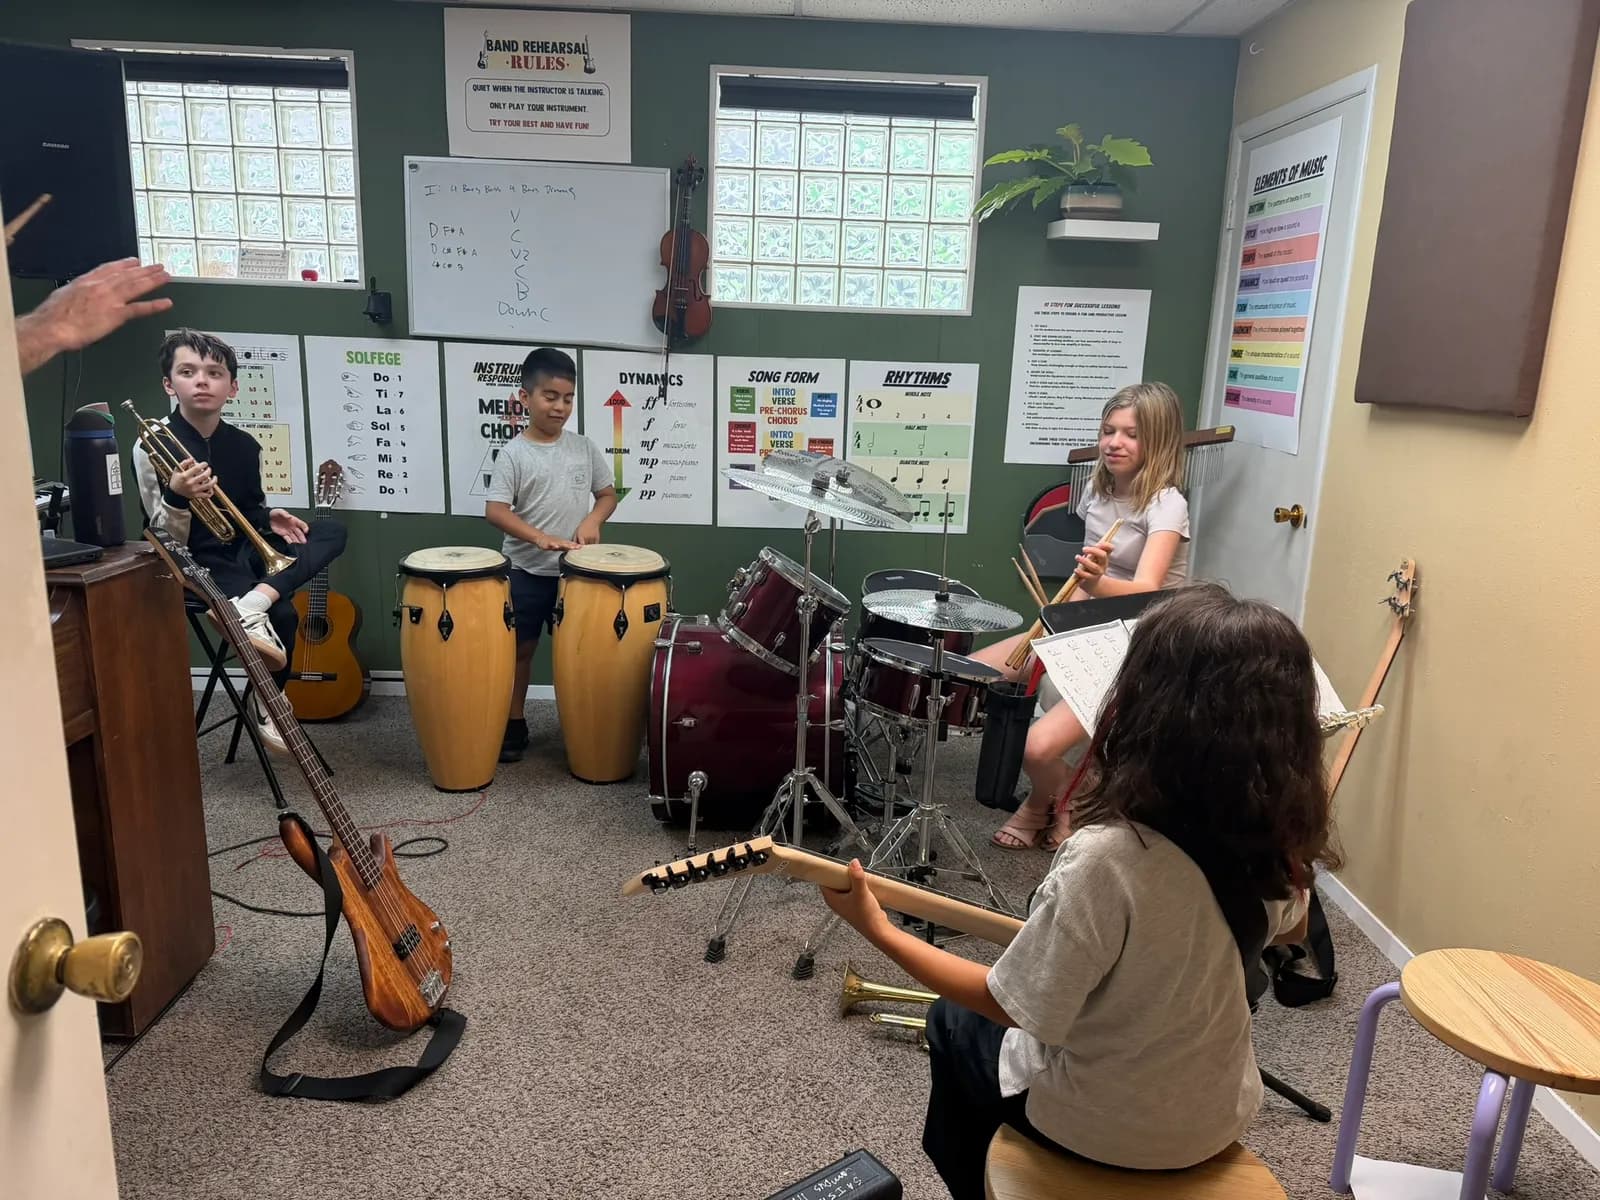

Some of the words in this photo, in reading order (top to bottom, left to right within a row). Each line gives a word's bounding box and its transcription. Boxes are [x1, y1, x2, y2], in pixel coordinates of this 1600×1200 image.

[487, 40, 518, 52] BAND
[523, 41, 588, 55] REHEARSAL
[473, 84, 489, 92] QUIET
[490, 102, 505, 110] ONLY
[523, 120, 537, 128] BEST
[1254, 168, 1288, 192] ELEMENTS
[1288, 164, 1300, 181] OF
[1299, 155, 1327, 178] MUSIC
[510, 208, 520, 223] V
[429, 222, 438, 238] D
[459, 227, 464, 236] A
[510, 229, 522, 242] C
[431, 243, 437, 254] D
[510, 248, 529, 261] V2
[514, 264, 526, 279] C
[516, 279, 529, 301] B
[540, 307, 552, 322] C
[346, 351, 402, 366] SOLFEGE
[373, 373, 389, 382] Do
[748, 370, 781, 383] SONG
[784, 372, 820, 384] FORM
[885, 370, 952, 385] RHYTHMS
[376, 389, 387, 398] Ti
[773, 388, 795, 396] INTRO
[642, 396, 659, 410] ff
[772, 397, 796, 405] VERSE
[377, 406, 391, 415] La
[478, 398, 529, 416] MELO
[760, 407, 807, 415] PRE-CHORUS
[371, 422, 390, 431] Sol
[643, 417, 655, 431] f
[377, 438, 390, 447] Fa
[640, 438, 659, 451] mf
[770, 440, 794, 448] VERSE
[378, 454, 392, 463] Mi
[639, 458, 658, 469] mp
[378, 470, 393, 478] Re
[643, 473, 652, 484] p
[379, 486, 395, 494] Do
[639, 490, 656, 500] pp
